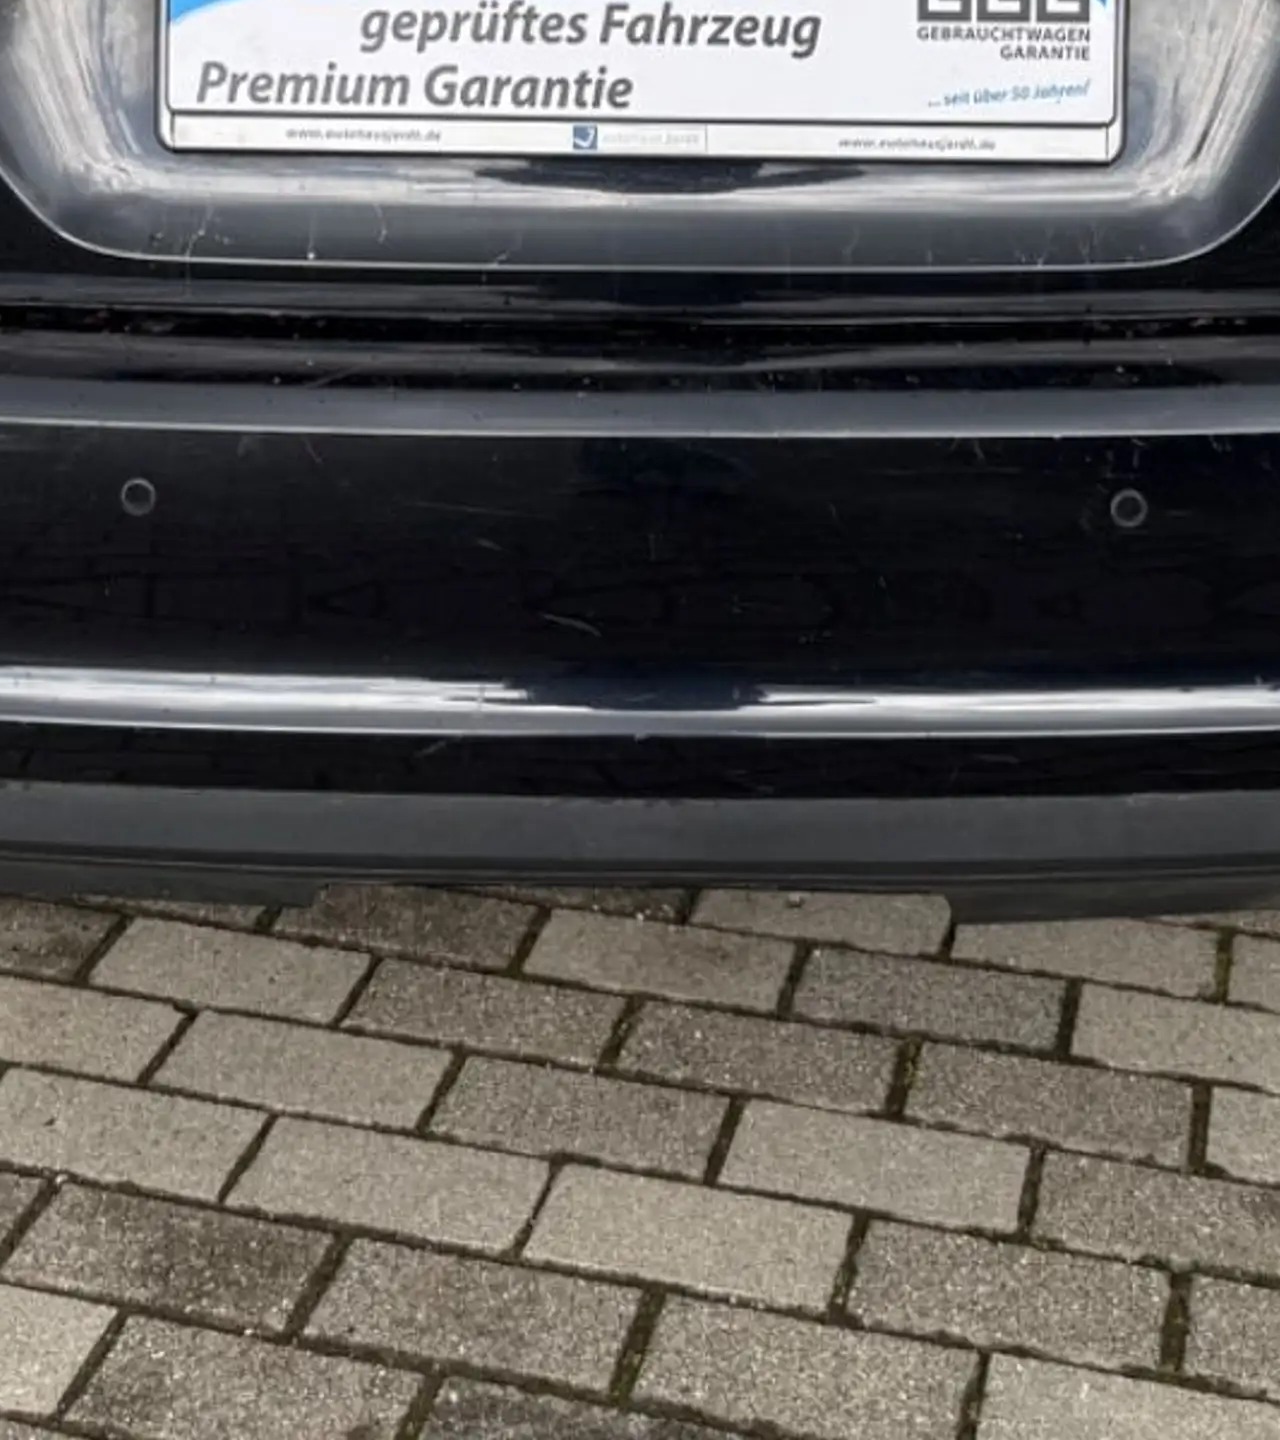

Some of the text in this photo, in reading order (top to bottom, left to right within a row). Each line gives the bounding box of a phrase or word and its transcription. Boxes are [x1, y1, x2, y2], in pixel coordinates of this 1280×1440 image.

[360, 0, 822, 59] geprüftes Fahrzeug
[917, 25, 1091, 42] GEBRAUCHTWAGEN
[999, 45, 1091, 61] GARANTIE
[197, 60, 634, 109] Premium Garantie
